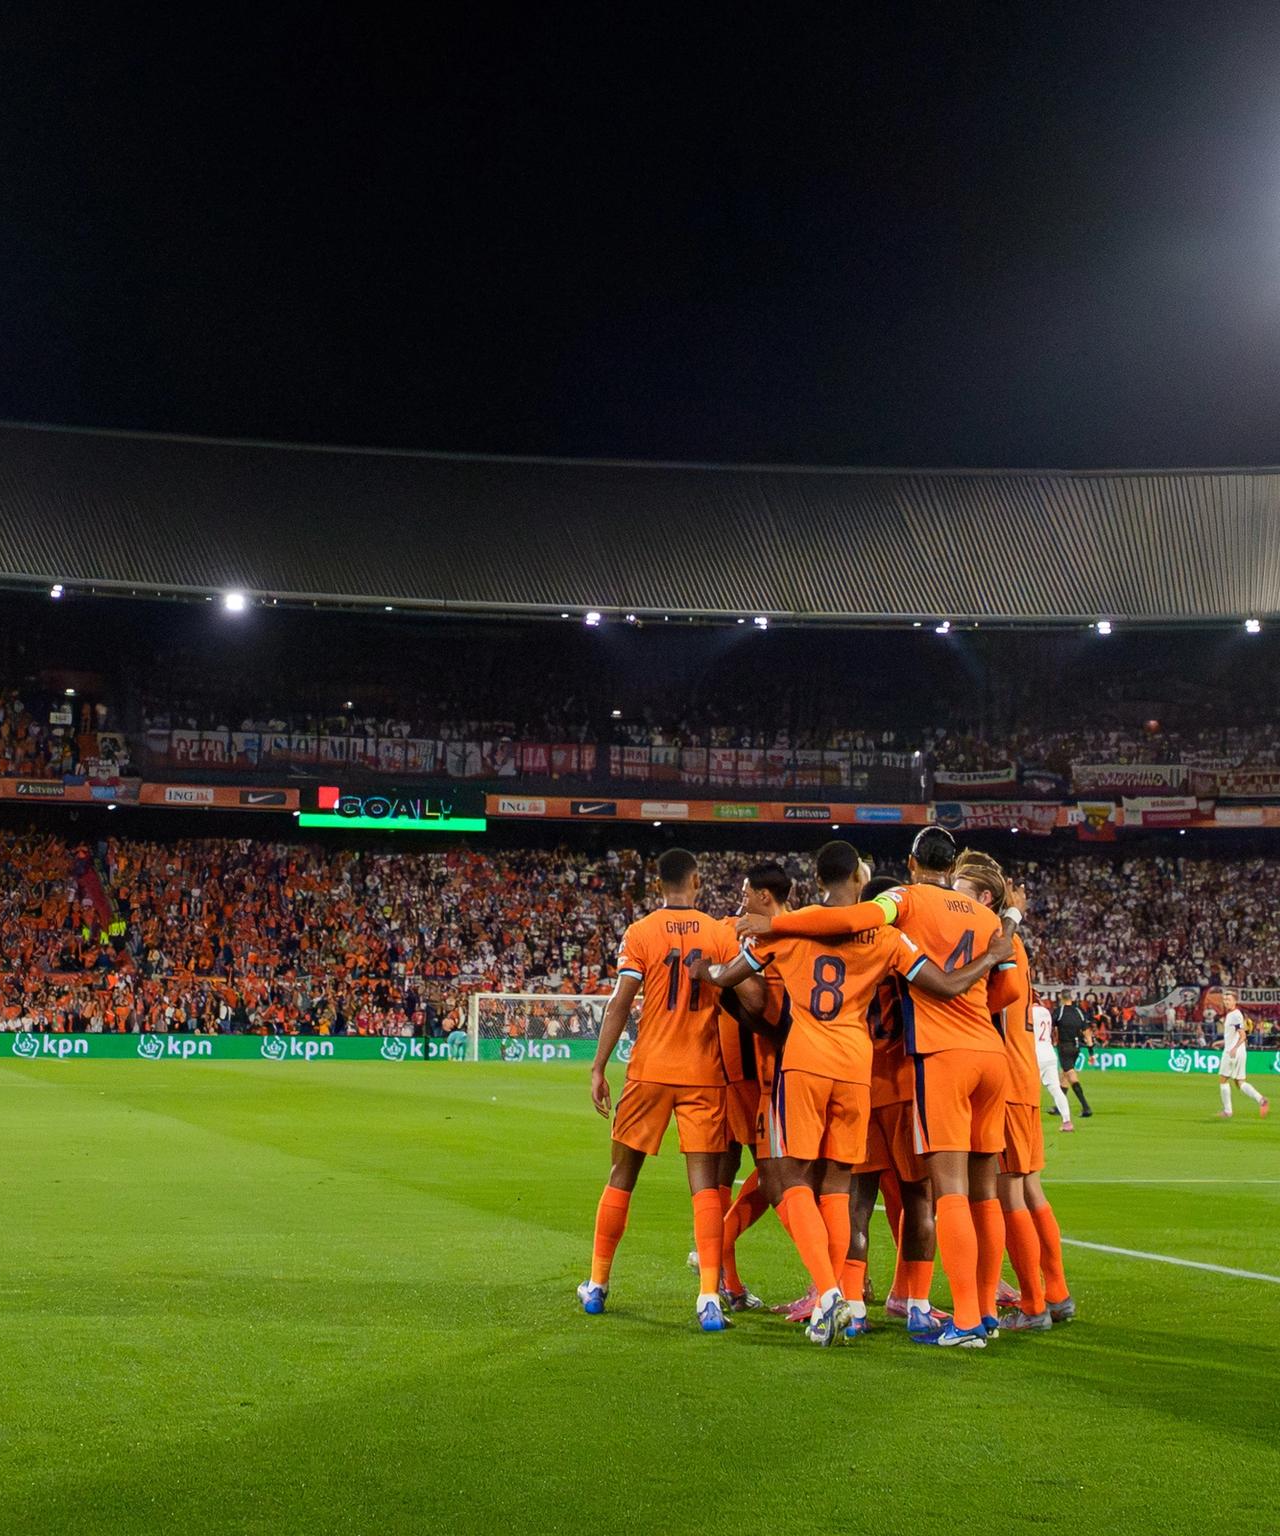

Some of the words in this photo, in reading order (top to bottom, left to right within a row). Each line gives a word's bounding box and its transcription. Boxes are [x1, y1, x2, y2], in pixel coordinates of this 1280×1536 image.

[169, 789, 195, 801] ING
[502, 800, 528, 812] ING
[944, 929, 975, 973] 4
[810, 954, 846, 1022] 8
[43, 1034, 88, 1057] kpn
[167, 1036, 212, 1059] kpn
[290, 1037, 333, 1061] kpn
[528, 1040, 570, 1062] kpn
[1194, 1051, 1220, 1073] kp
